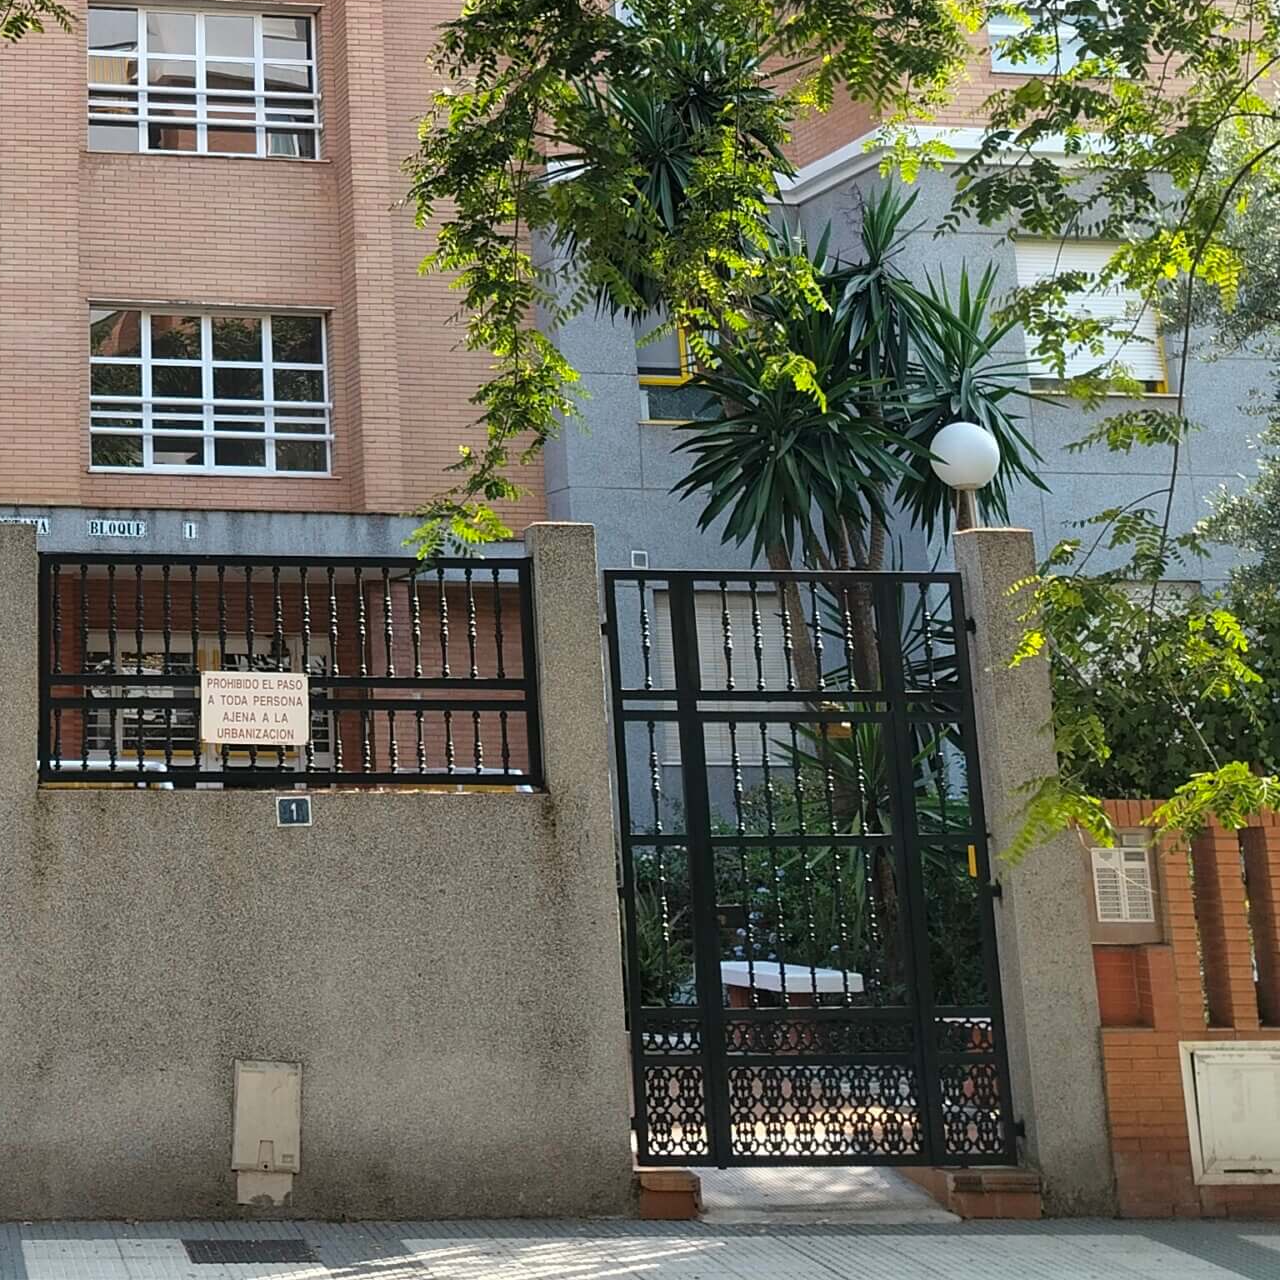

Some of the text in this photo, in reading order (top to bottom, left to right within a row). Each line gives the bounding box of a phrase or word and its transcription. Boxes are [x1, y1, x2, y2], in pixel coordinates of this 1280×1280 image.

[90, 521, 145, 536] BLOQUE
[207, 678, 303, 690] PROHIBIDO EL PASO
[207, 694, 303, 707] A TODA PERSONA
[222, 711, 288, 723] AJENA A LA
[217, 728, 294, 740] URBANIZACION
[290, 802, 297, 821] 1
